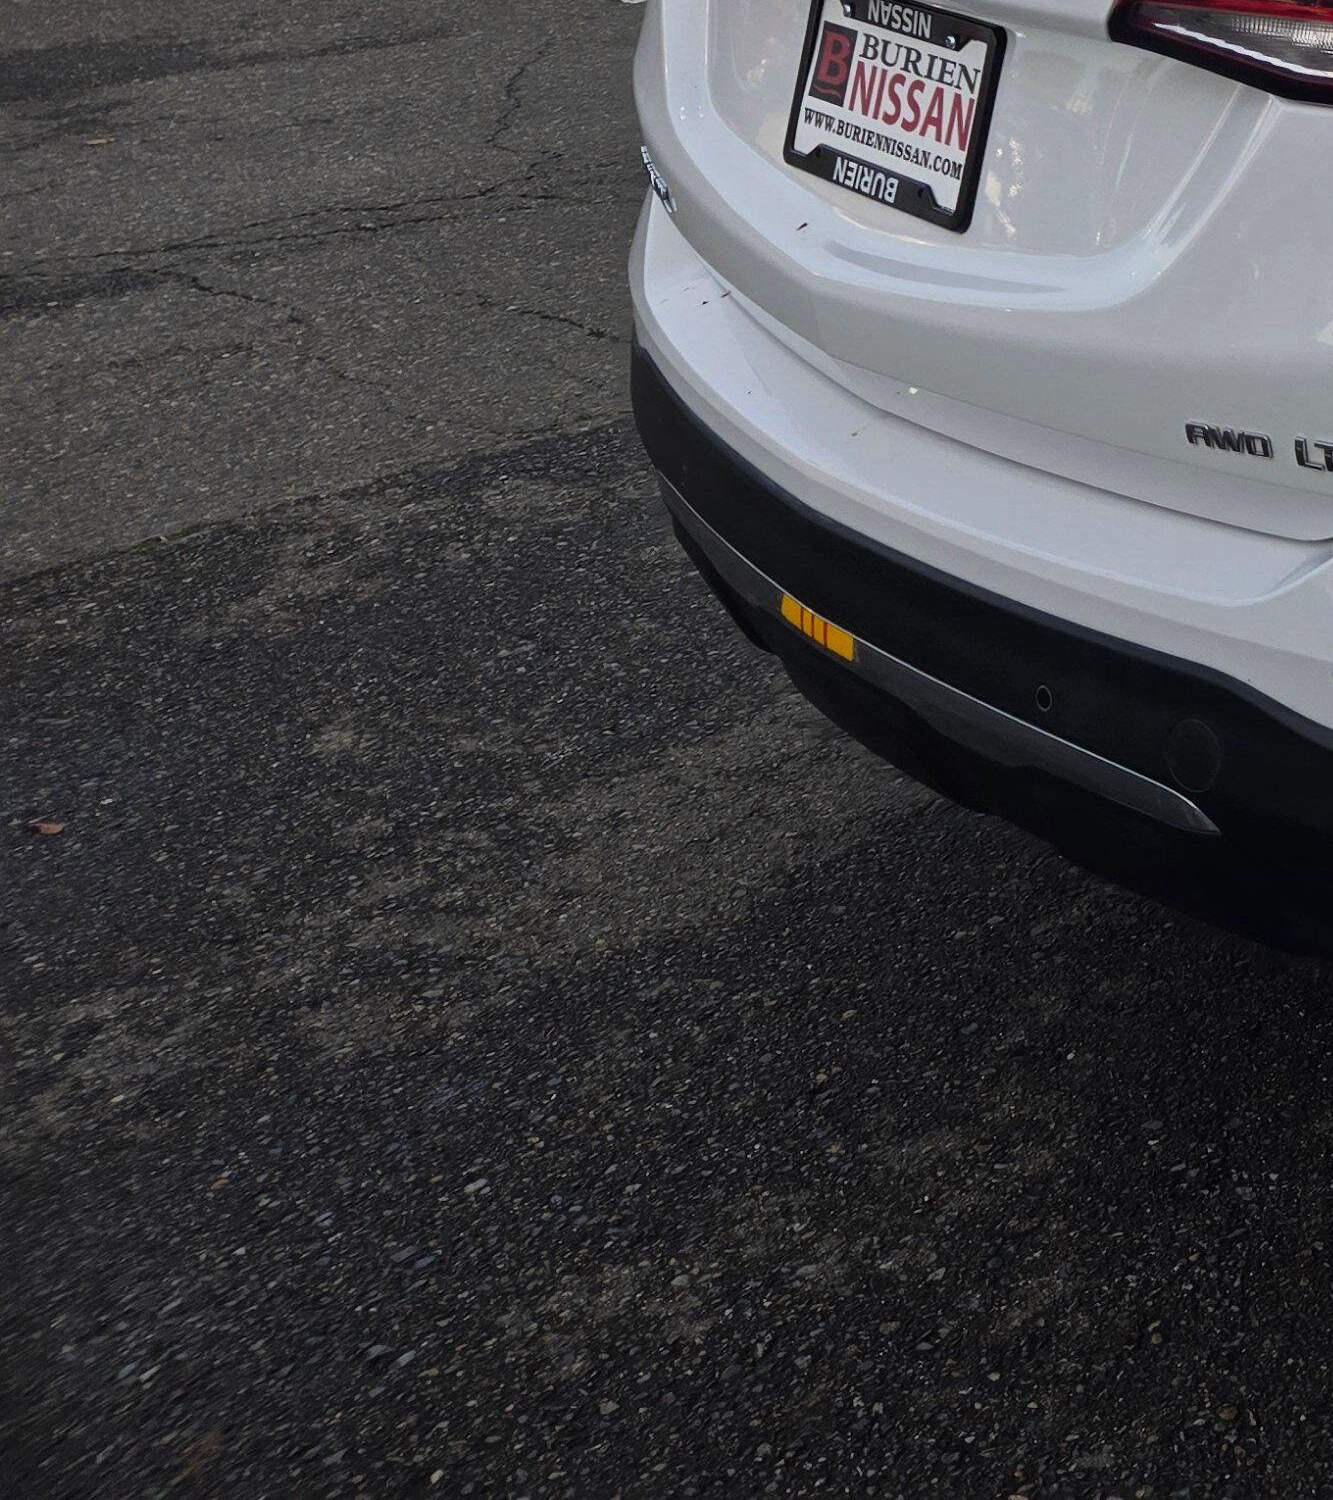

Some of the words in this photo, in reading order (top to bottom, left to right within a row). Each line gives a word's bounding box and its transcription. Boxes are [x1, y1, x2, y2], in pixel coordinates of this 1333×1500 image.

[817, 30, 851, 85] B
[859, 33, 981, 94] BURIEN
[849, 61, 976, 151] NISSAN
[804, 108, 963, 181] WWW.BURIENNISSAN.COM
[832, 156, 899, 203] BURIEN
[1185, 418, 1274, 459] AWD
